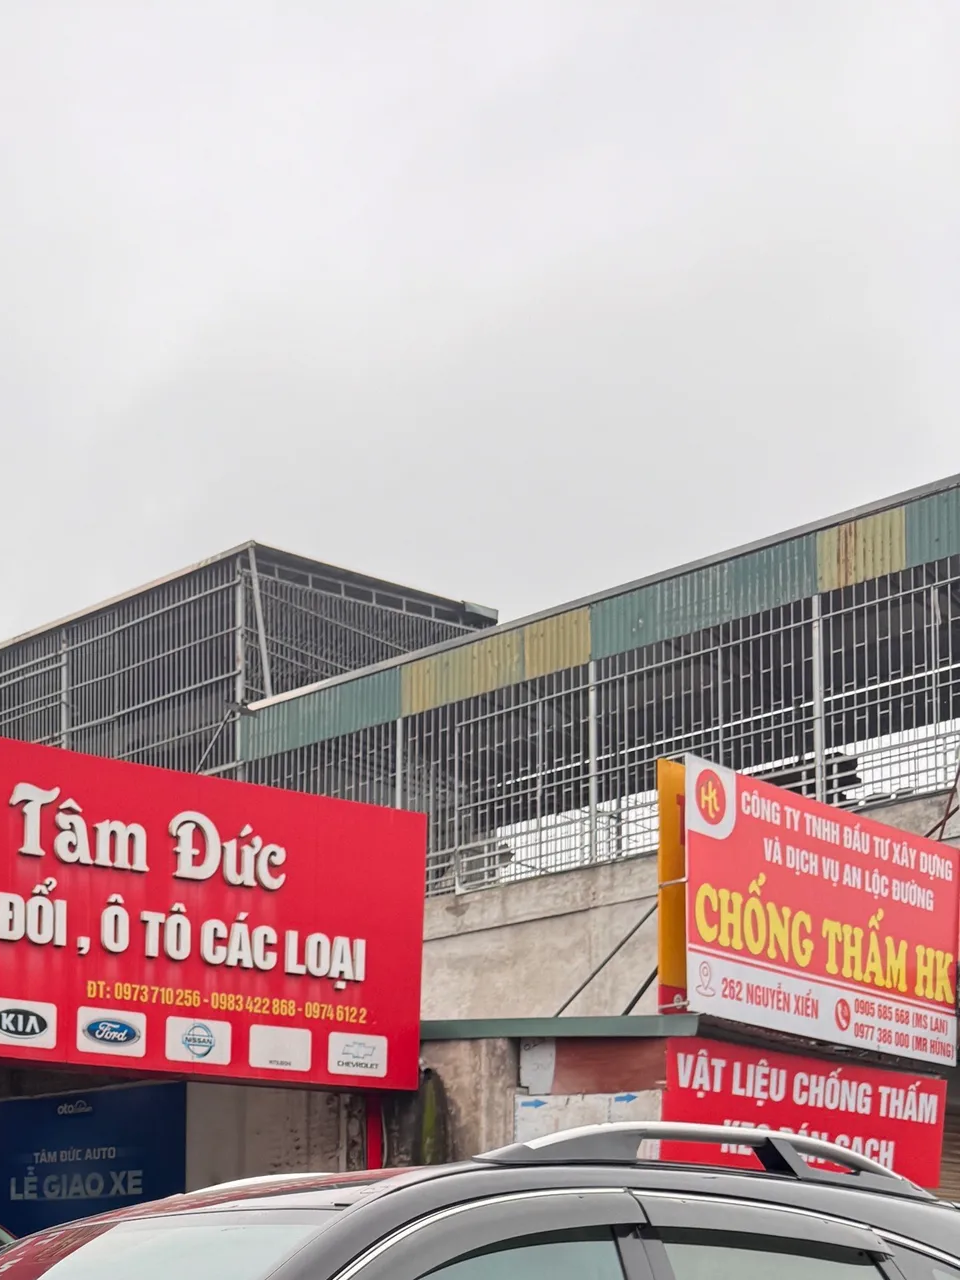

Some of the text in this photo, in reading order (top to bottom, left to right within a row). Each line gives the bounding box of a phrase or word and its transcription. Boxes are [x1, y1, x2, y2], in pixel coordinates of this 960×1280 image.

[9, 782, 287, 891] Tâm Đức
[741, 789, 780, 825] CÔNG
[784, 806, 800, 831] TY
[804, 812, 840, 845] TNHH
[873, 835, 891, 860] TƯ
[892, 841, 917, 870] XÂY
[919, 852, 953, 883] DỰNG
[763, 836, 782, 865] VÀ
[786, 844, 819, 877] DỊCH
[822, 856, 840, 887] VỤ
[842, 863, 862, 890] AN
[865, 868, 889, 900] LỘC
[101, 894, 130, 953] Ô
[141, 902, 191, 961] TÔ
[200, 912, 278, 971] CÁC
[284, 929, 366, 990] LOẠI
[914, 944, 955, 1005] HK
[87, 980, 111, 999] ĐT:
[722, 977, 743, 1002] 262
[1, 1013, 40, 1033] KIA
[95, 1022, 128, 1042] Ford
[184, 1036, 213, 1046] NISSAN
[337, 1060, 379, 1070] CHEVROLET
[677, 1048, 938, 1125] VẬT LIỆU CHỐNG THẤM
[34, 1149, 57, 1164] TÂM
[84, 1146, 116, 1160] AUTO
[43, 1171, 104, 1199] GIAO
[109, 1169, 143, 1195] XE
